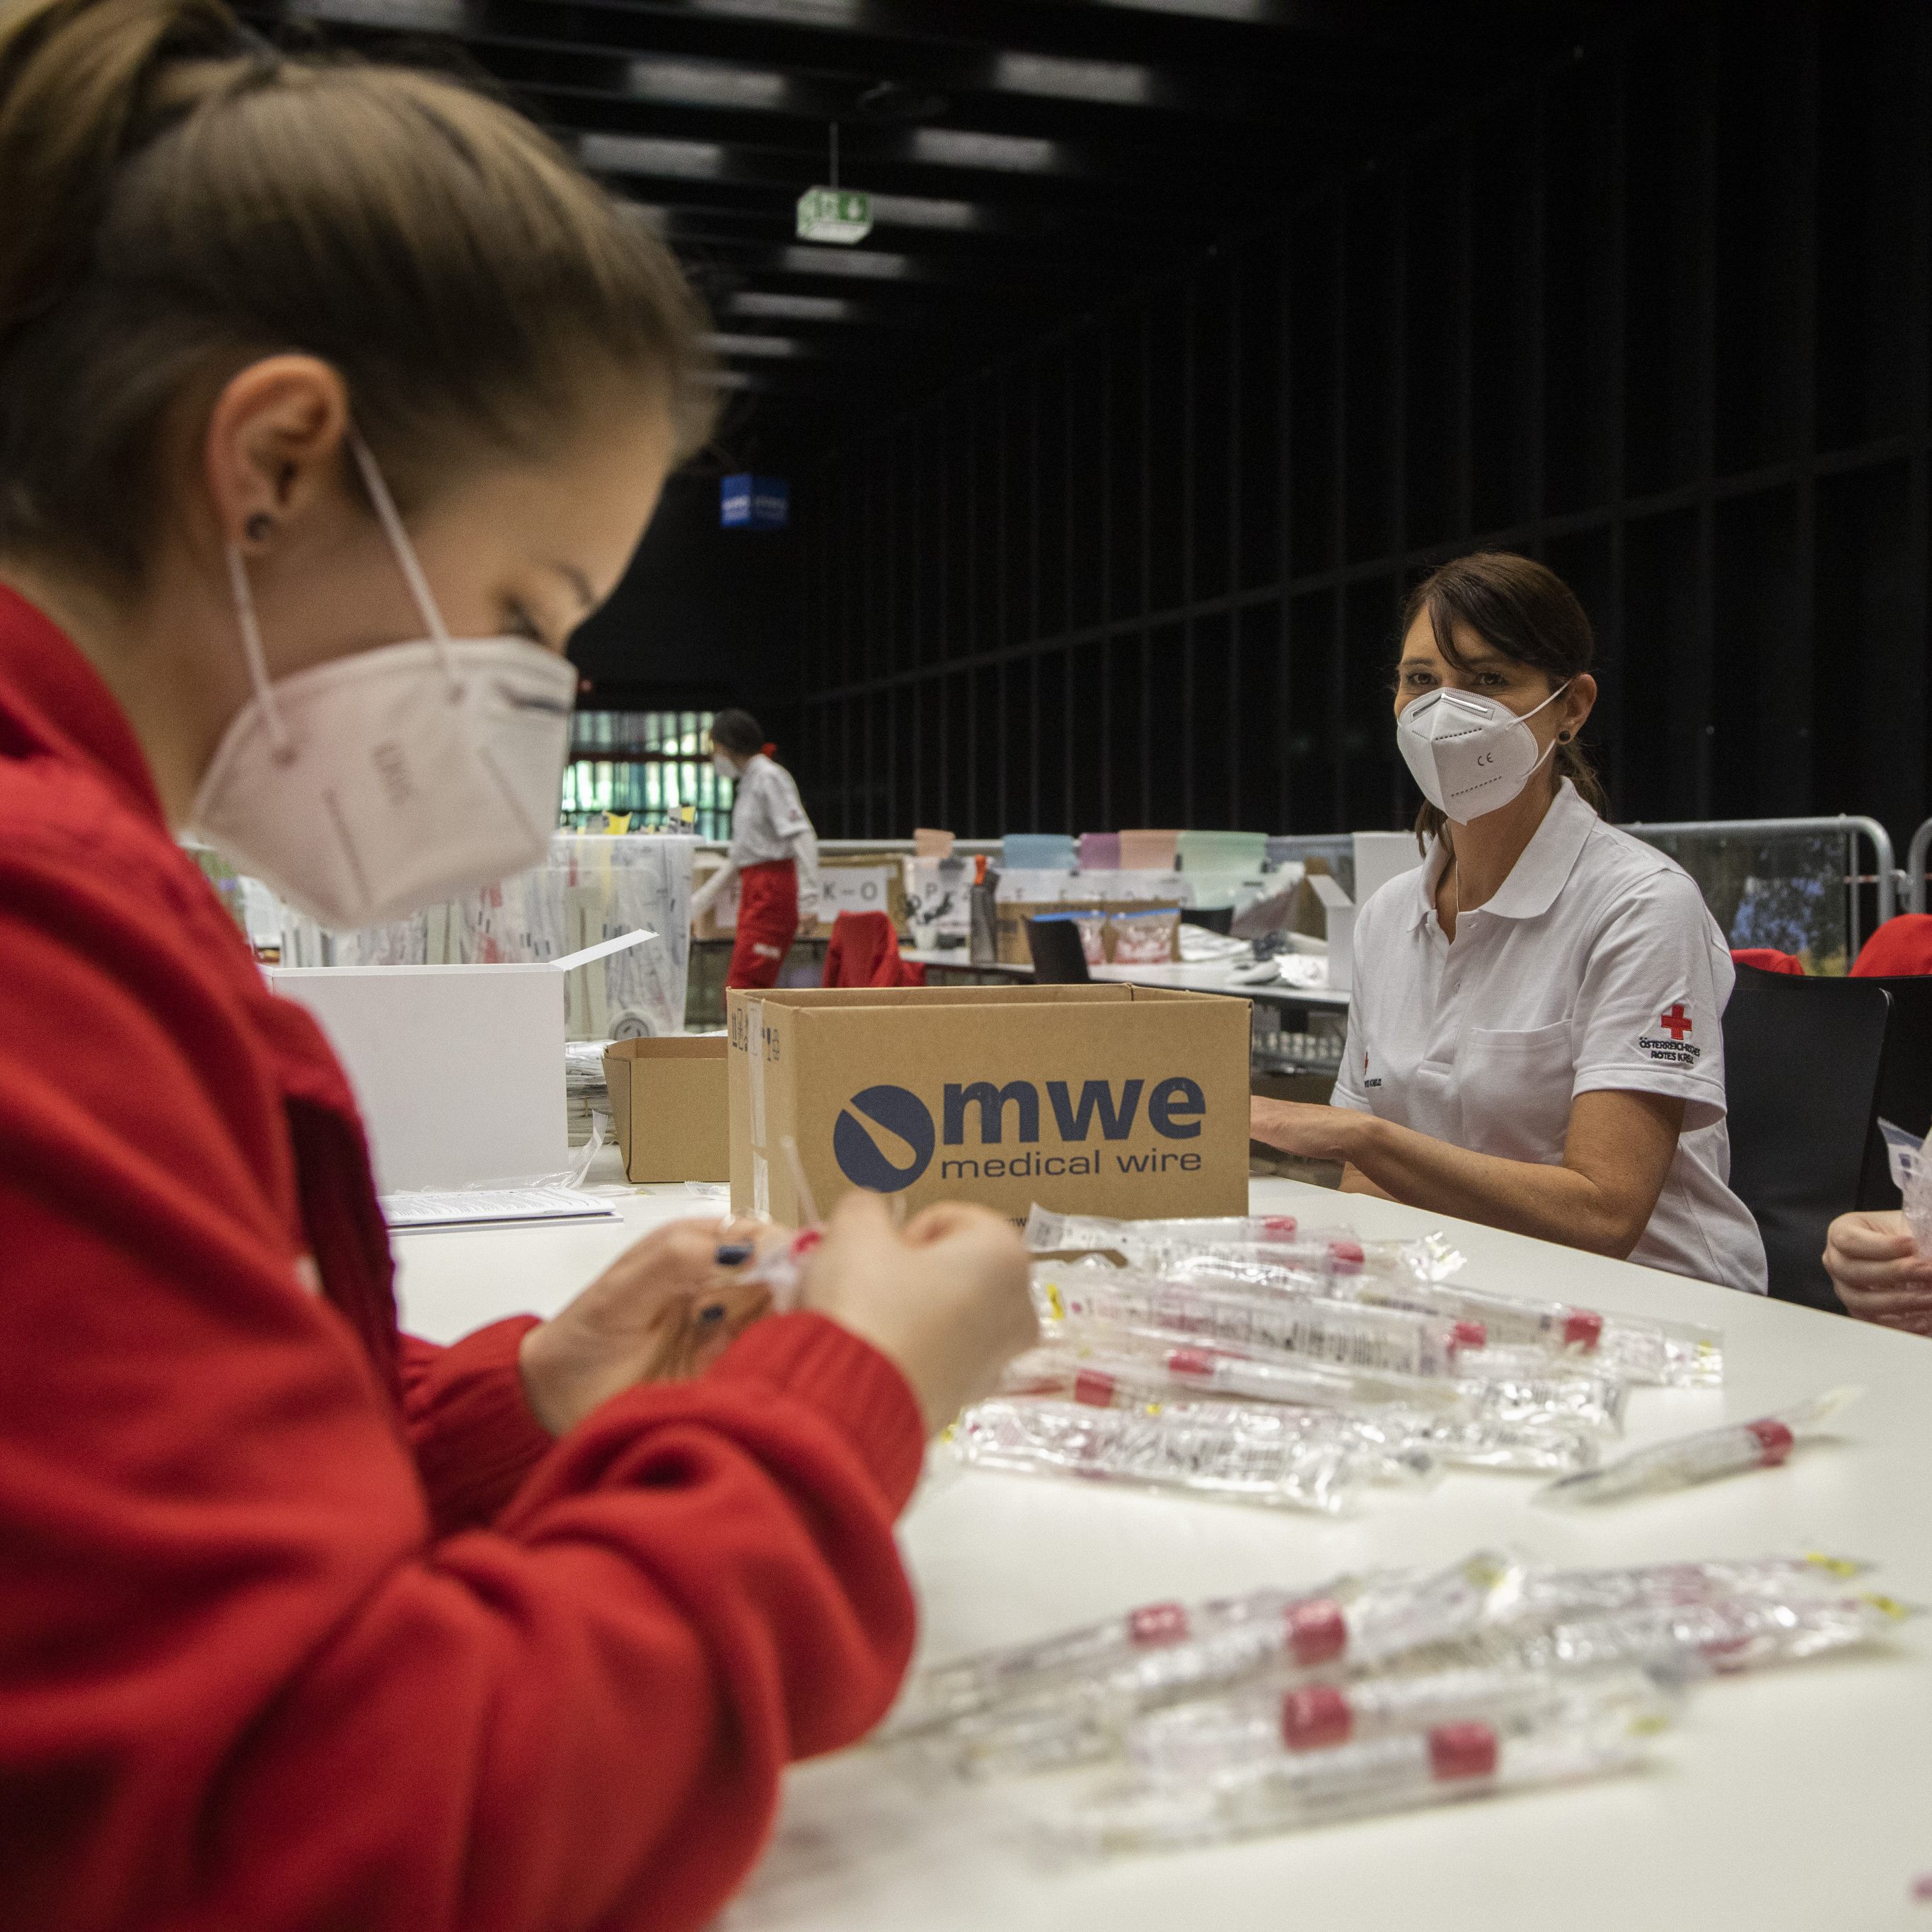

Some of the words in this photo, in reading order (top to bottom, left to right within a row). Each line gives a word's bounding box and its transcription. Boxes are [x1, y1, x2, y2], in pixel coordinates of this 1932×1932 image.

[1650, 1050, 1677, 1061] ROTES
[942, 1076, 1207, 1145] mwe
[941, 1150, 1101, 1179] medical
[1116, 1147, 1202, 1174] wire
